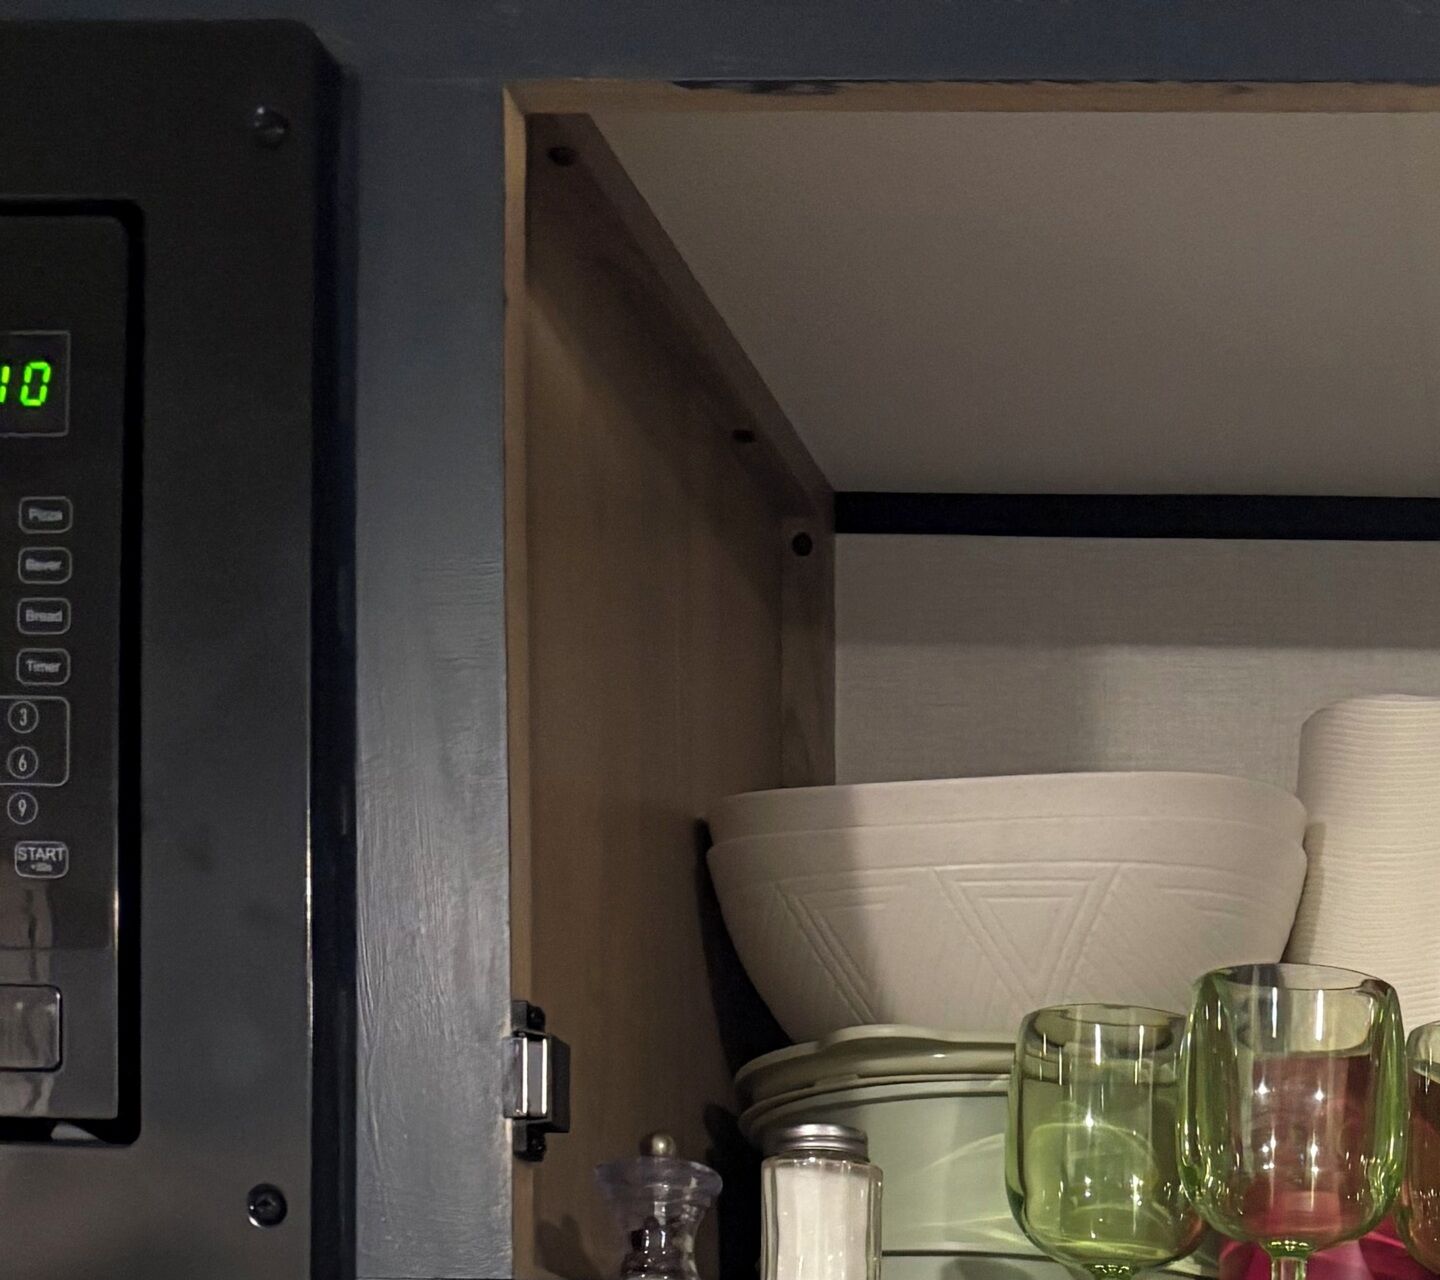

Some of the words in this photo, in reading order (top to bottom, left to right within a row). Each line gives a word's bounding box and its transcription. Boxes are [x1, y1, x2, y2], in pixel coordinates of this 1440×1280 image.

[19, 708, 28, 726] 3
[18, 753, 27, 772] 6
[18, 799, 27, 817] 9
[17, 847, 66, 862] START
